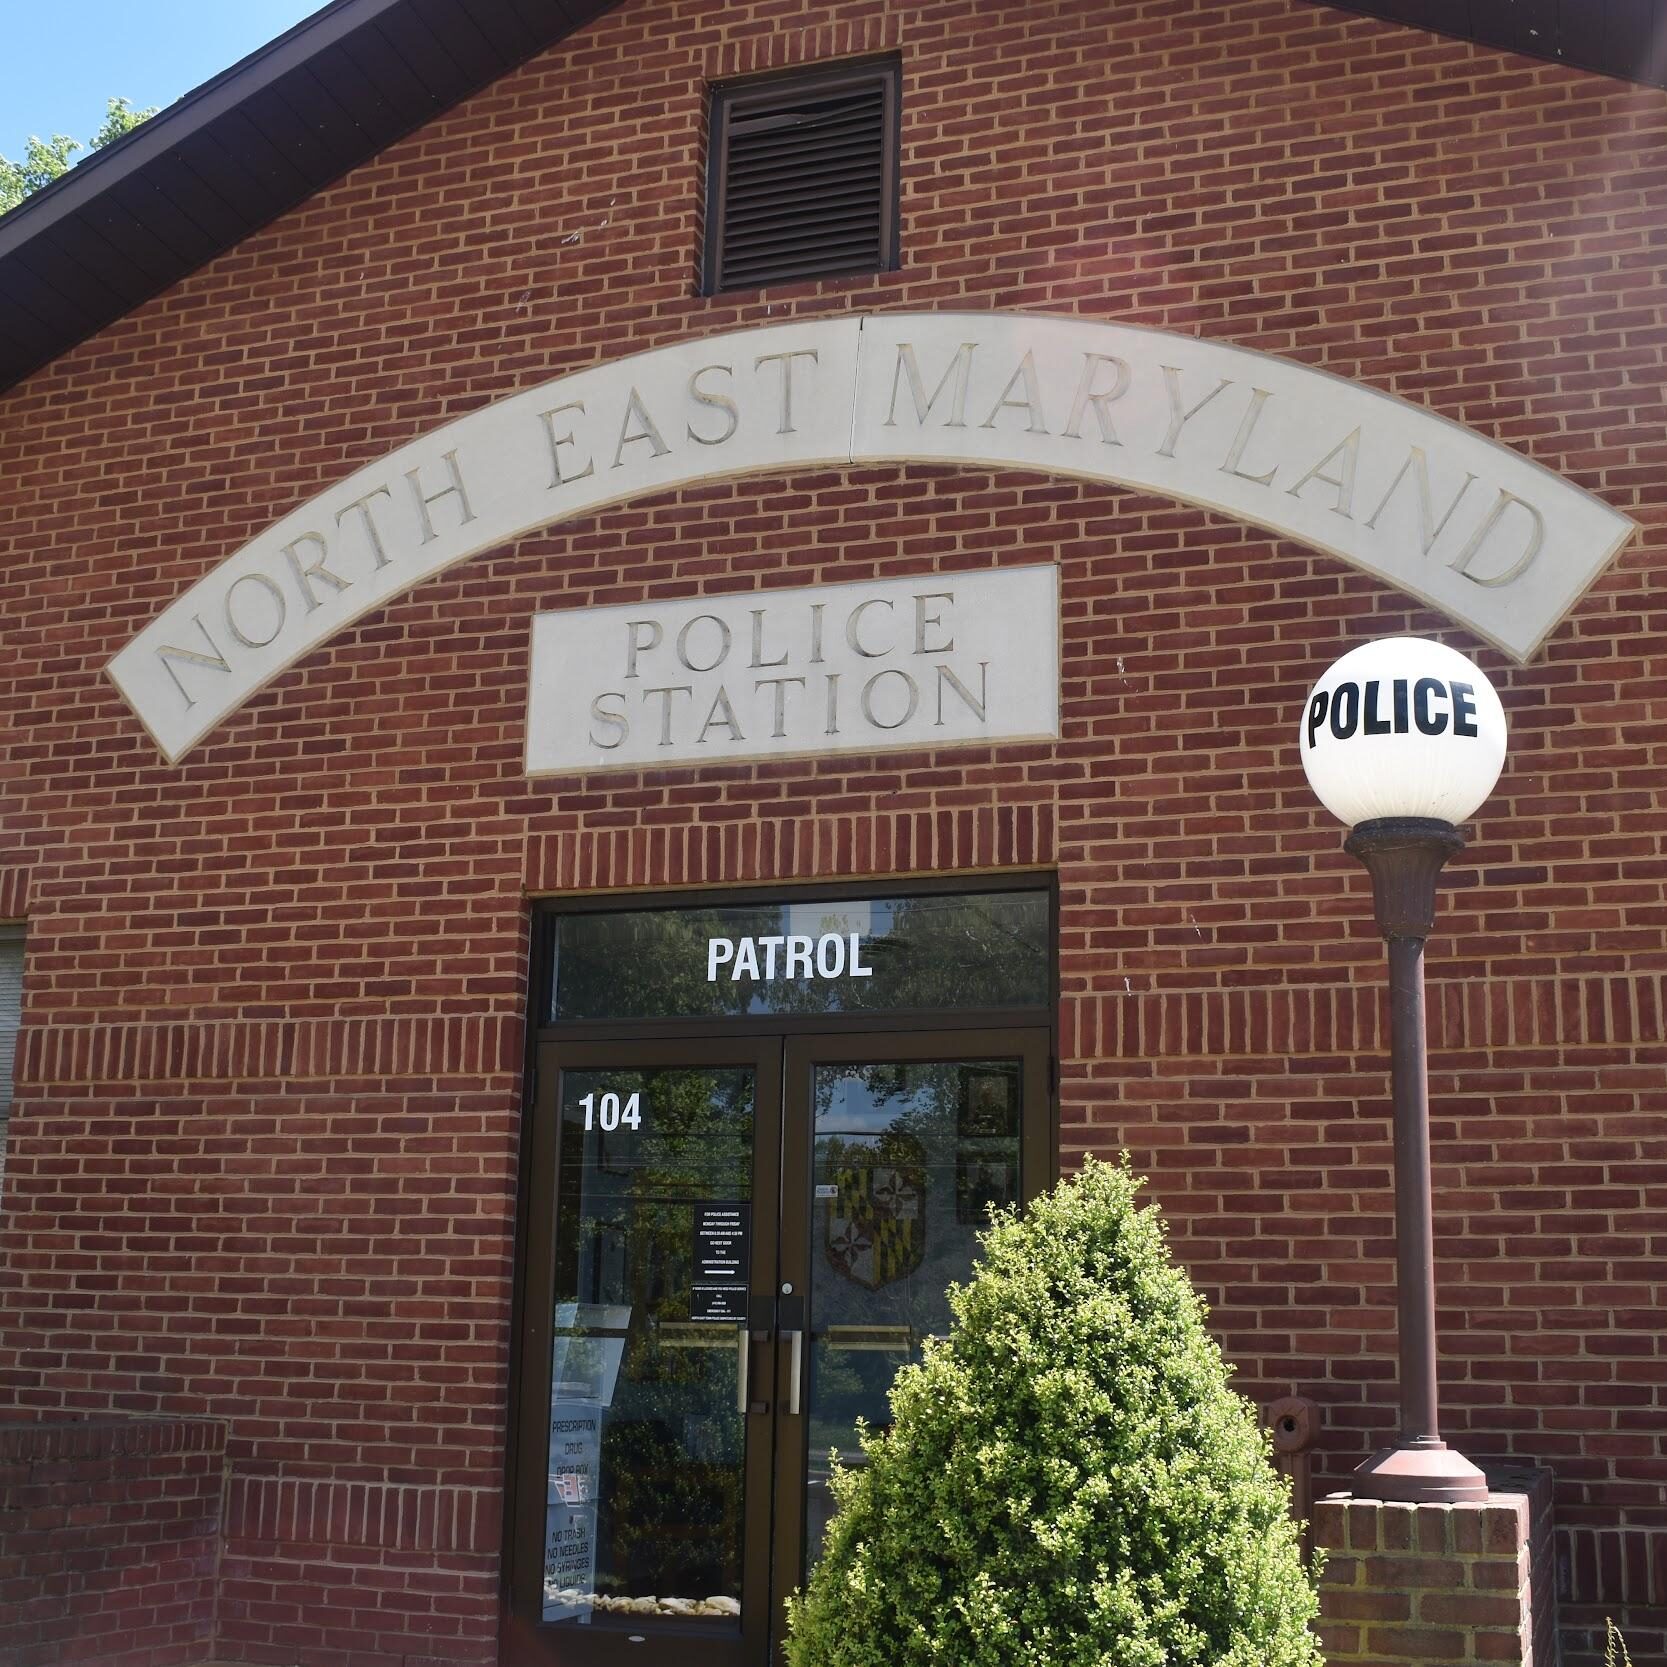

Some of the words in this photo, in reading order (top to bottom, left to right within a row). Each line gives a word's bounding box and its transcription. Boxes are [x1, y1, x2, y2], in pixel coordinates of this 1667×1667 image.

[153, 447, 477, 712] NORTH
[537, 349, 820, 489] EAST
[883, 341, 1547, 588] MARYLAND
[624, 592, 955, 679] POLICE
[589, 661, 991, 749] STATION
[1308, 677, 1478, 749] POLICE
[707, 932, 873, 982] PATROL
[578, 1092, 642, 1132] 104
[552, 1420, 596, 1432] PRESCRIPTION
[564, 1442, 583, 1455] DRUG
[547, 1547, 558, 1560] NO
[560, 1542, 589, 1557] NEEDLES
[552, 1530, 562, 1543] NO
[564, 1528, 586, 1540] TRASH
[558, 1557, 589, 1574] SYRINGES
